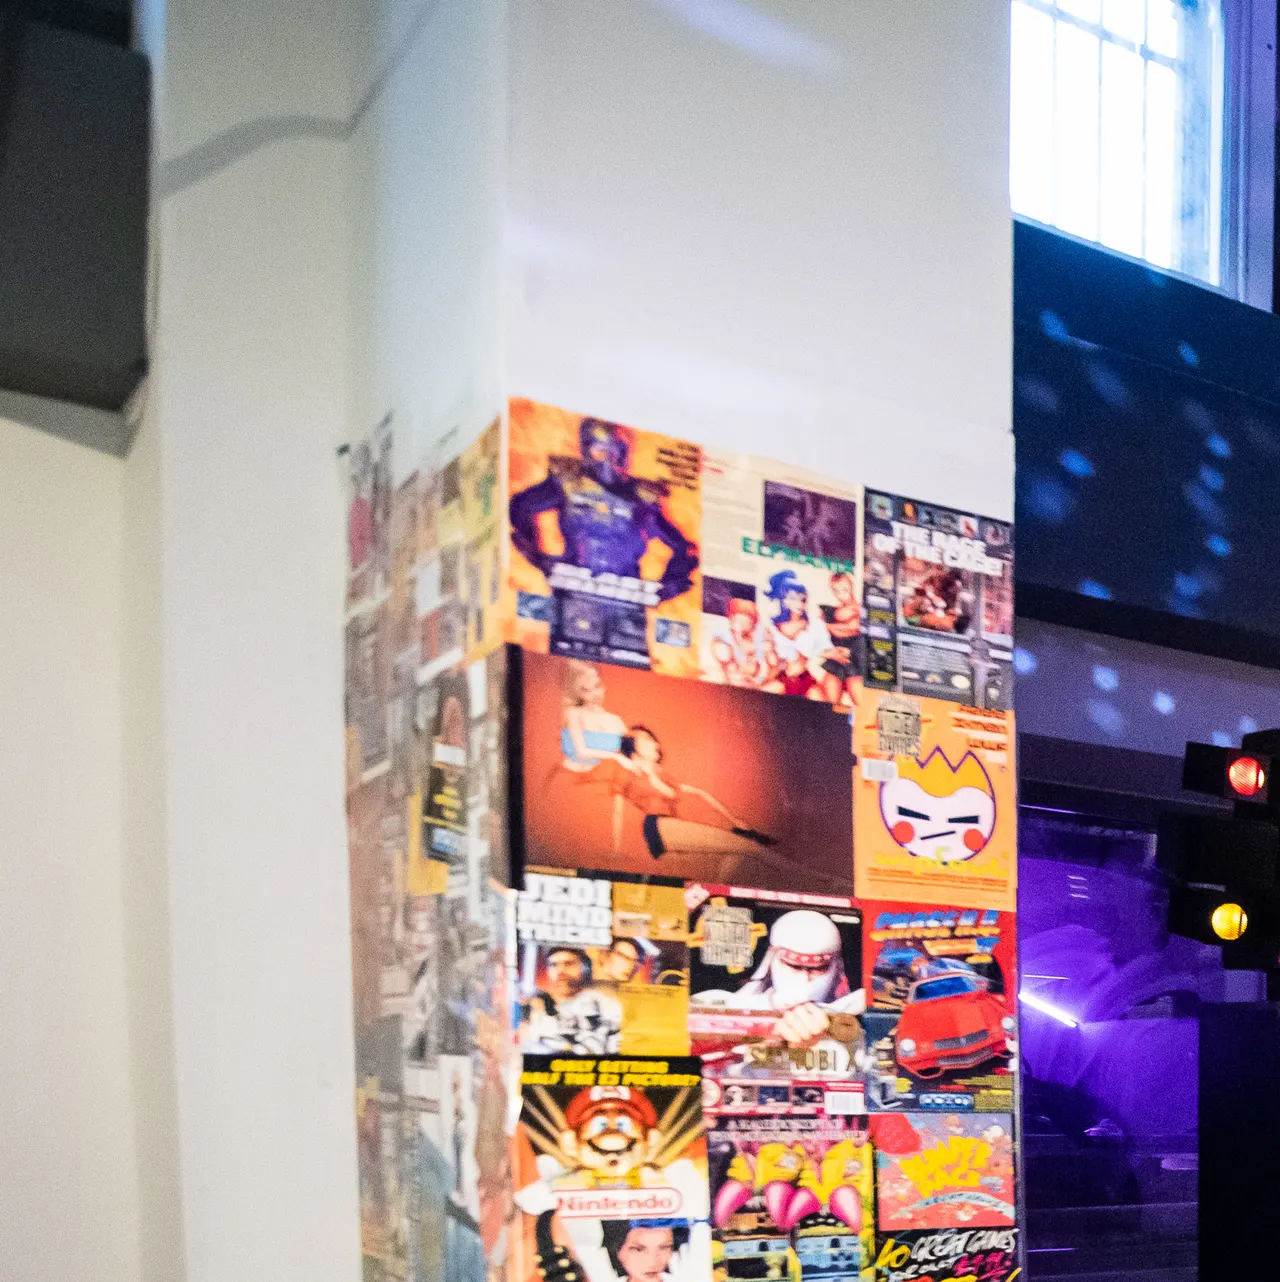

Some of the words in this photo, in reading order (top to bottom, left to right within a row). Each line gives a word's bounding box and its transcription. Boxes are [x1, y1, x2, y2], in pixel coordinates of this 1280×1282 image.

[891, 522, 938, 545] THE
[872, 533, 901, 554] OF
[902, 541, 942, 563] THE
[522, 873, 612, 908] JEDI
[517, 904, 612, 930] MIND
[557, 1194, 673, 1212] Nintendo
[911, 1230, 976, 1261] GREAT
